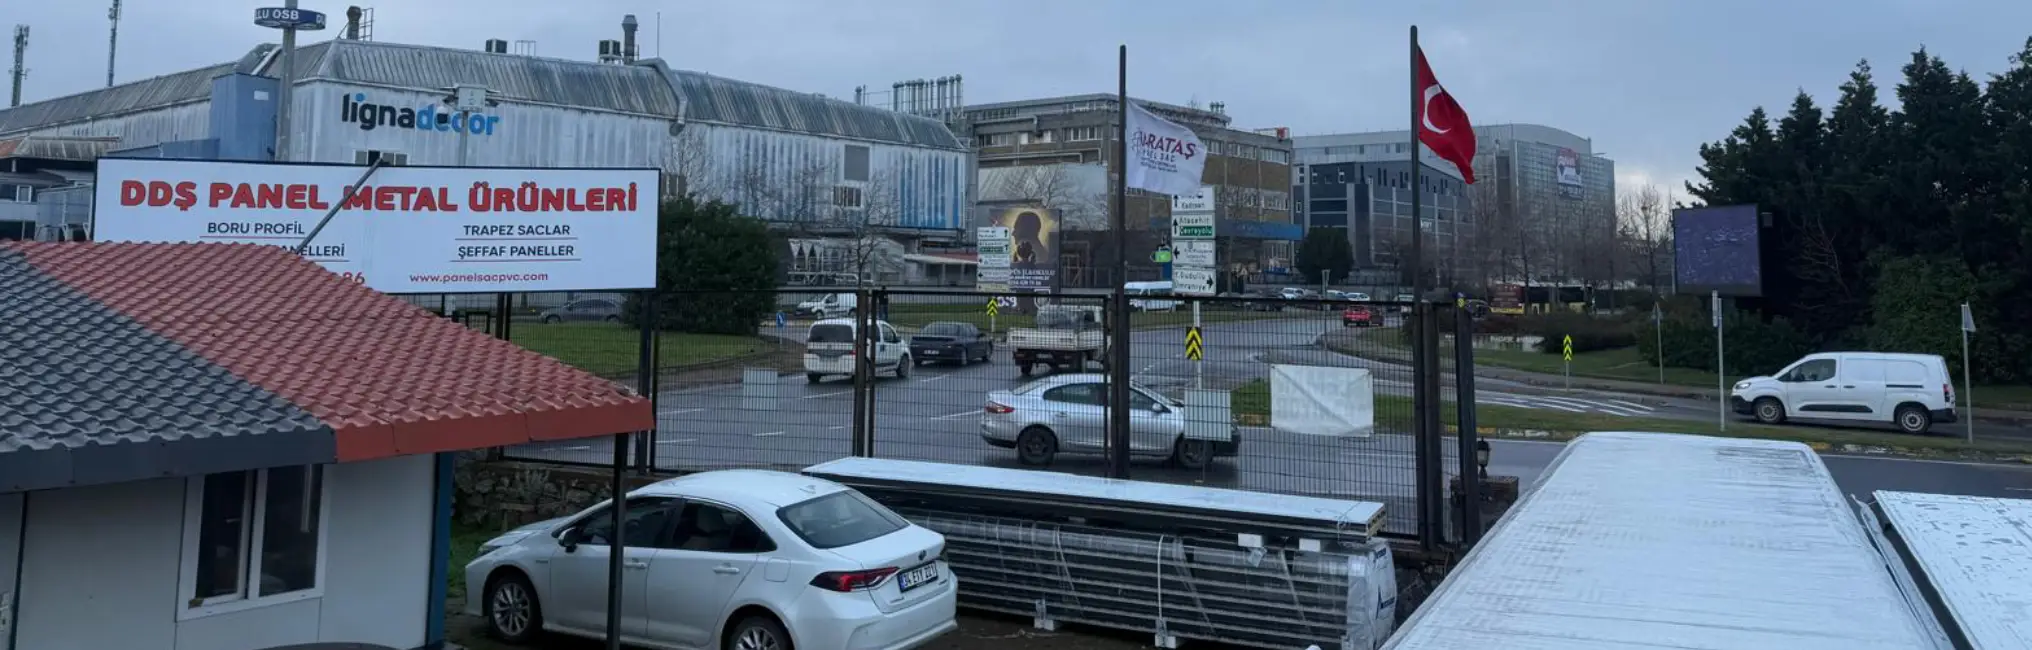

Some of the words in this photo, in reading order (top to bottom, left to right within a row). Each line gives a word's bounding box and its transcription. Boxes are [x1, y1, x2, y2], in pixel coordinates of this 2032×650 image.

[272, 8, 299, 20] OSB
[120, 180, 197, 211] DDŞ
[208, 182, 329, 210] PANEL
[343, 185, 458, 212] METAL
[468, 181, 637, 212] ÜRÜNLERİ
[207, 222, 250, 234] BORU
[254, 221, 305, 234] PROFİL
[463, 225, 514, 236] TRAPEZ
[517, 224, 570, 236] SACLAR
[458, 245, 506, 260] ŞEFFAF
[510, 245, 574, 257] PANELLER
[409, 272, 548, 284] www.panelsacpvc.com
